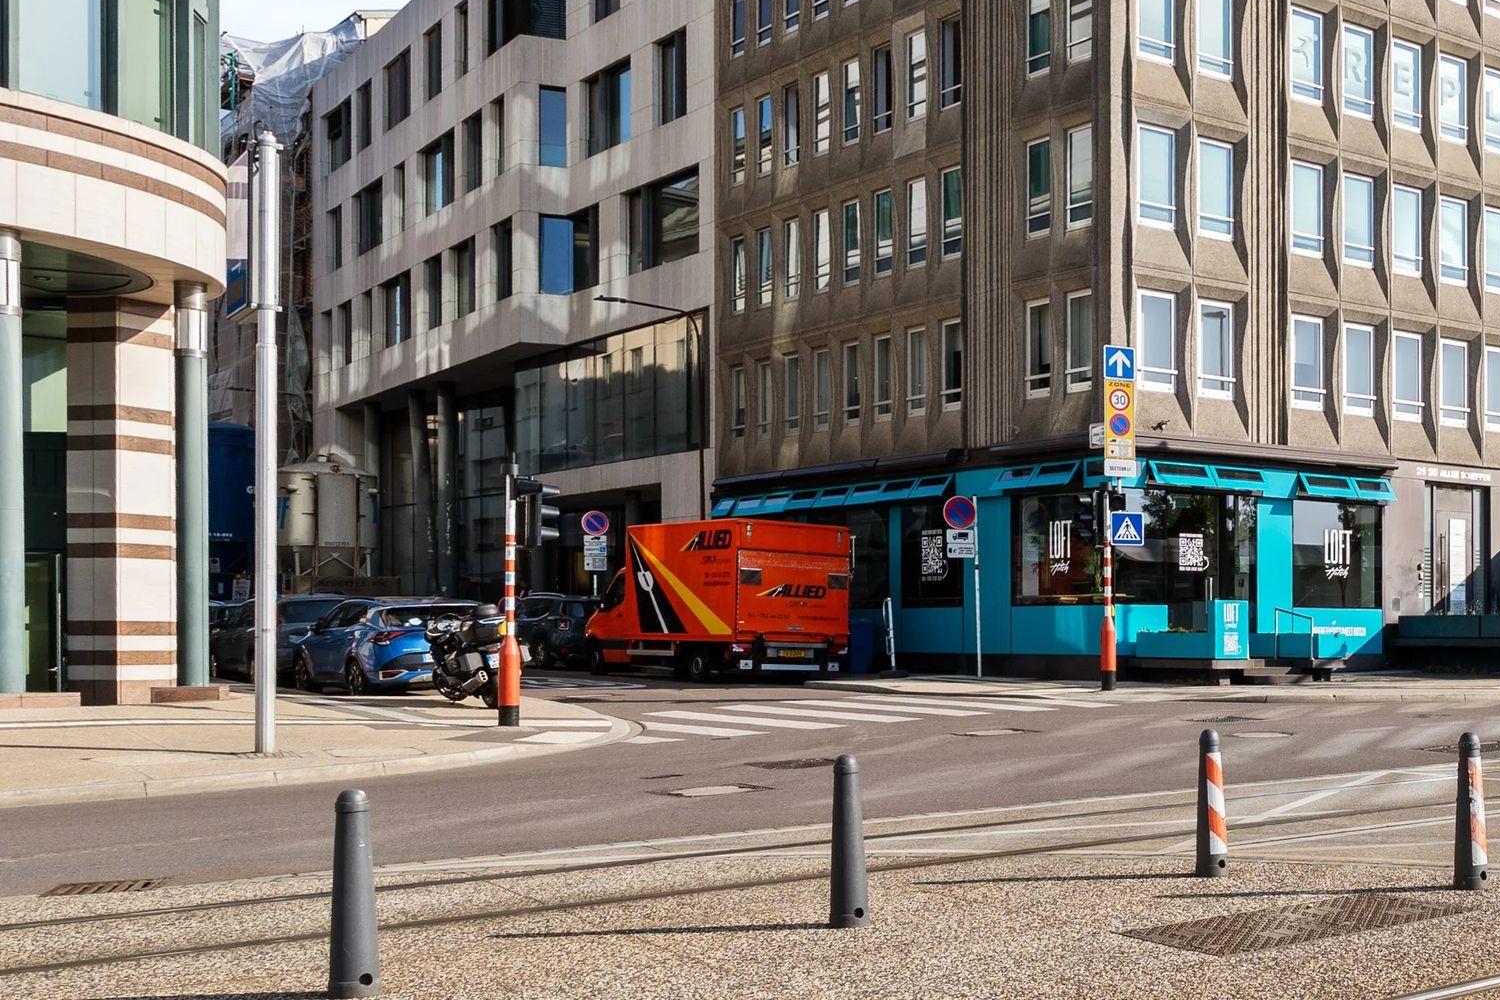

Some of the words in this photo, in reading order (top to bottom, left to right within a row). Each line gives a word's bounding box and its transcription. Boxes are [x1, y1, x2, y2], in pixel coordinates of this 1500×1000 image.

[1113, 394, 1126, 406] 30
[686, 529, 732, 551] ALLIED
[1049, 520, 1072, 559] LOFT
[1324, 528, 1352, 565] LOFT
[767, 584, 827, 599] ALLIED
[1223, 603, 1240, 622] LOFT
